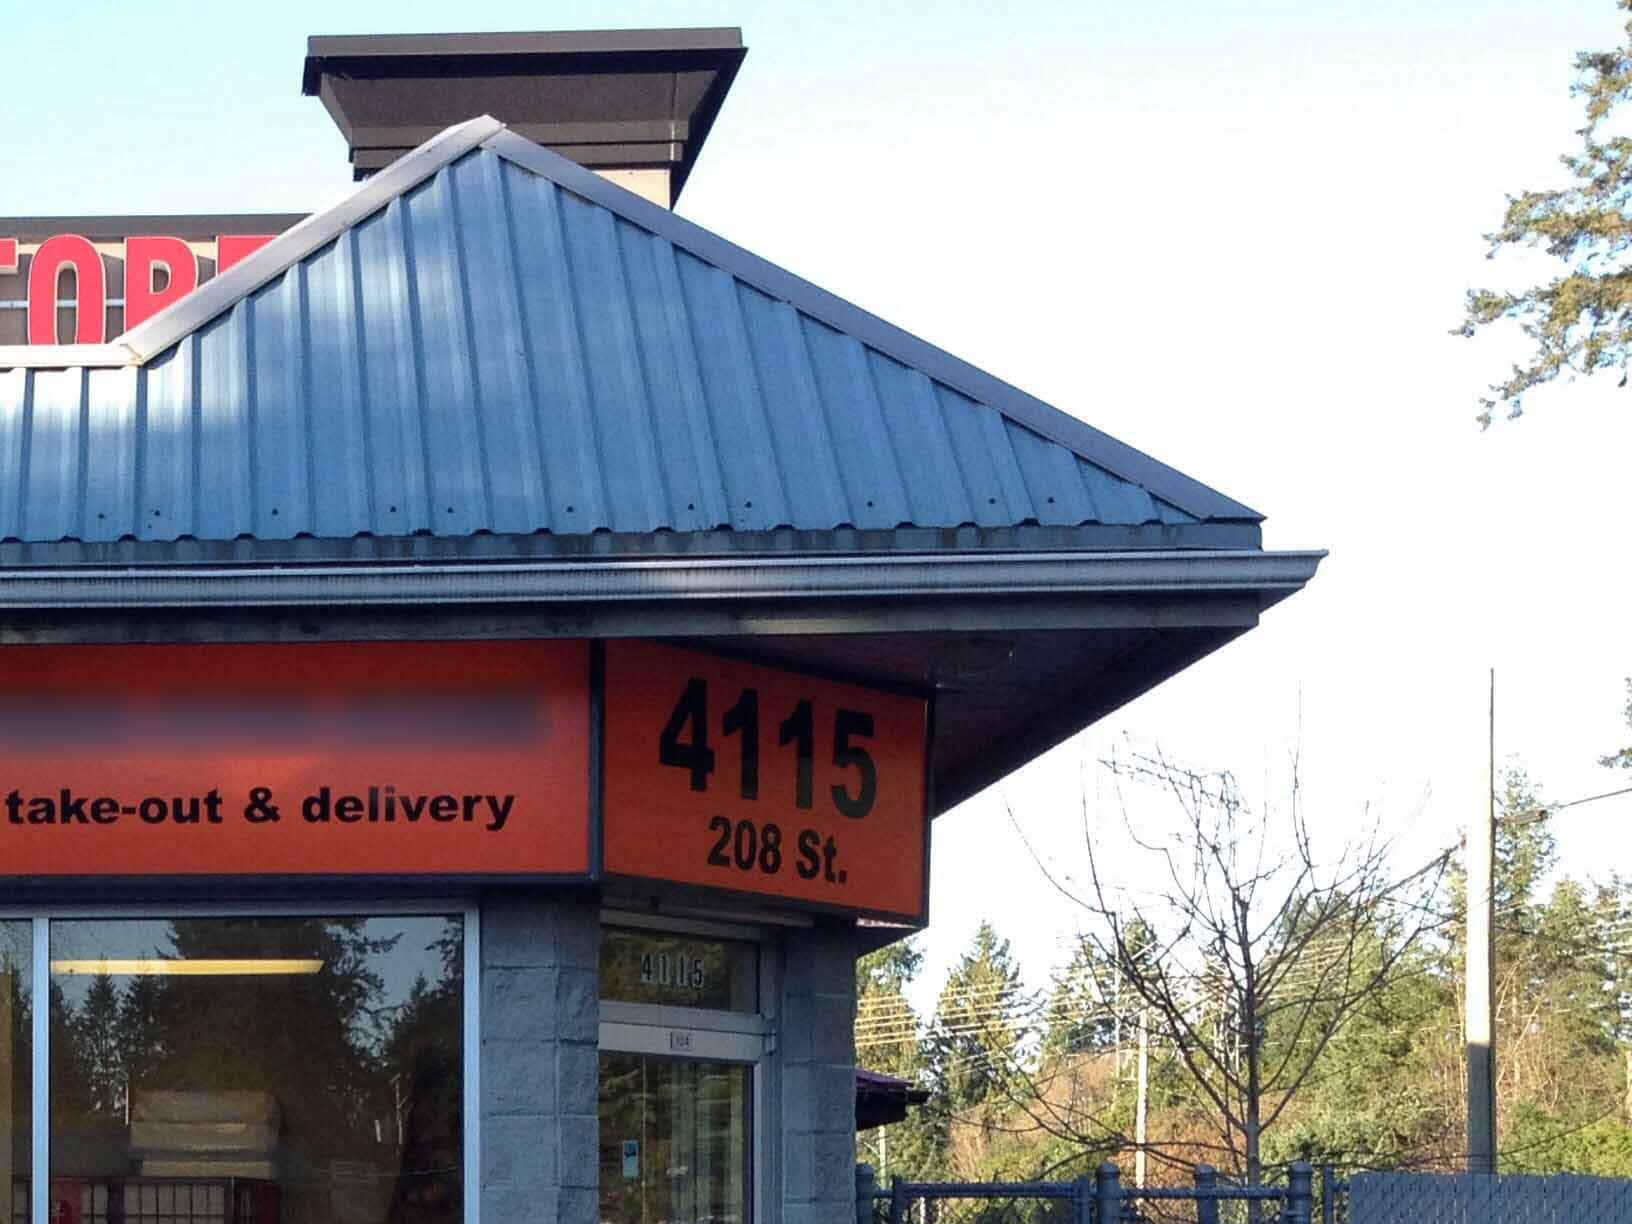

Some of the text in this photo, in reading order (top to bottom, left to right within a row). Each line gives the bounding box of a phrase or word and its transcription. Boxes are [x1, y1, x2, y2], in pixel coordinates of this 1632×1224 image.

[658, 677, 877, 820] 4115
[5, 786, 516, 831] take-out & delivery
[707, 816, 848, 884] 208 St.
[641, 952, 704, 988] 4115
